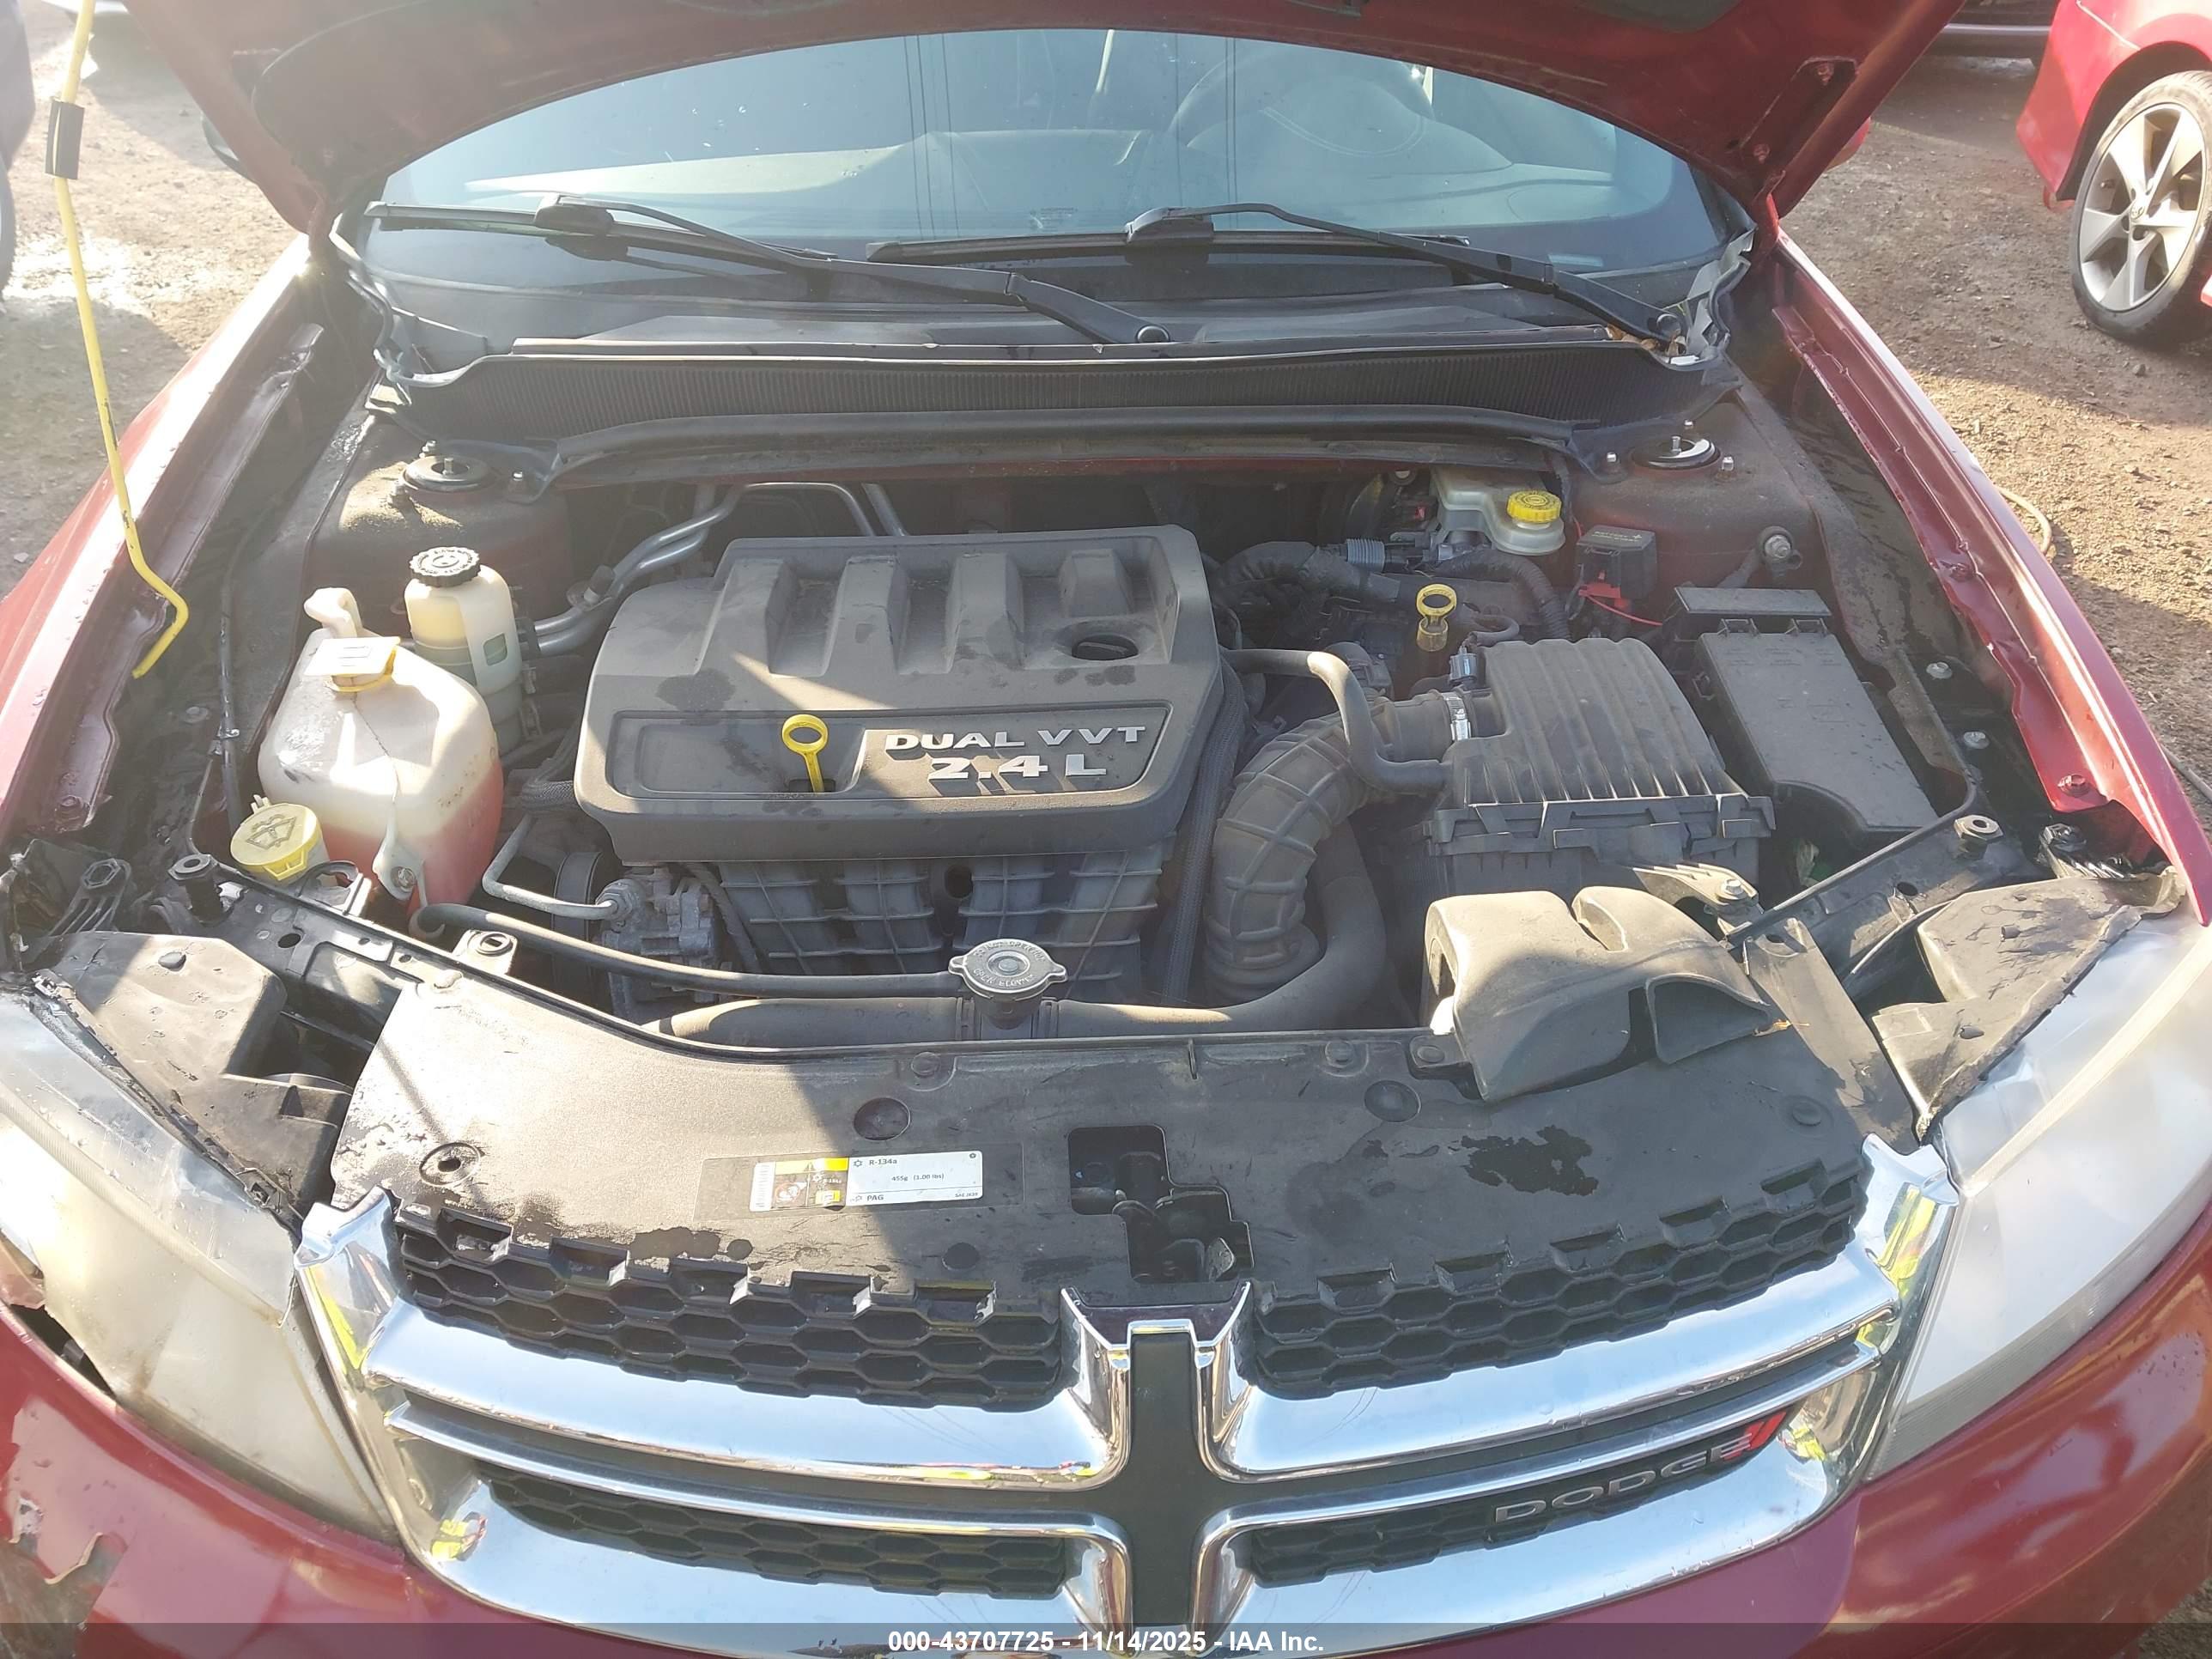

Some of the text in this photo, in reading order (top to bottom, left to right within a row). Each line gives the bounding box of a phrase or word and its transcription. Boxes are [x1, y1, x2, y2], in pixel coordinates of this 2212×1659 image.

[885, 726, 1146, 751] DUAL VVT
[869, 1158, 898, 1166] R-134a
[1495, 1432, 1753, 1523] DODGE
